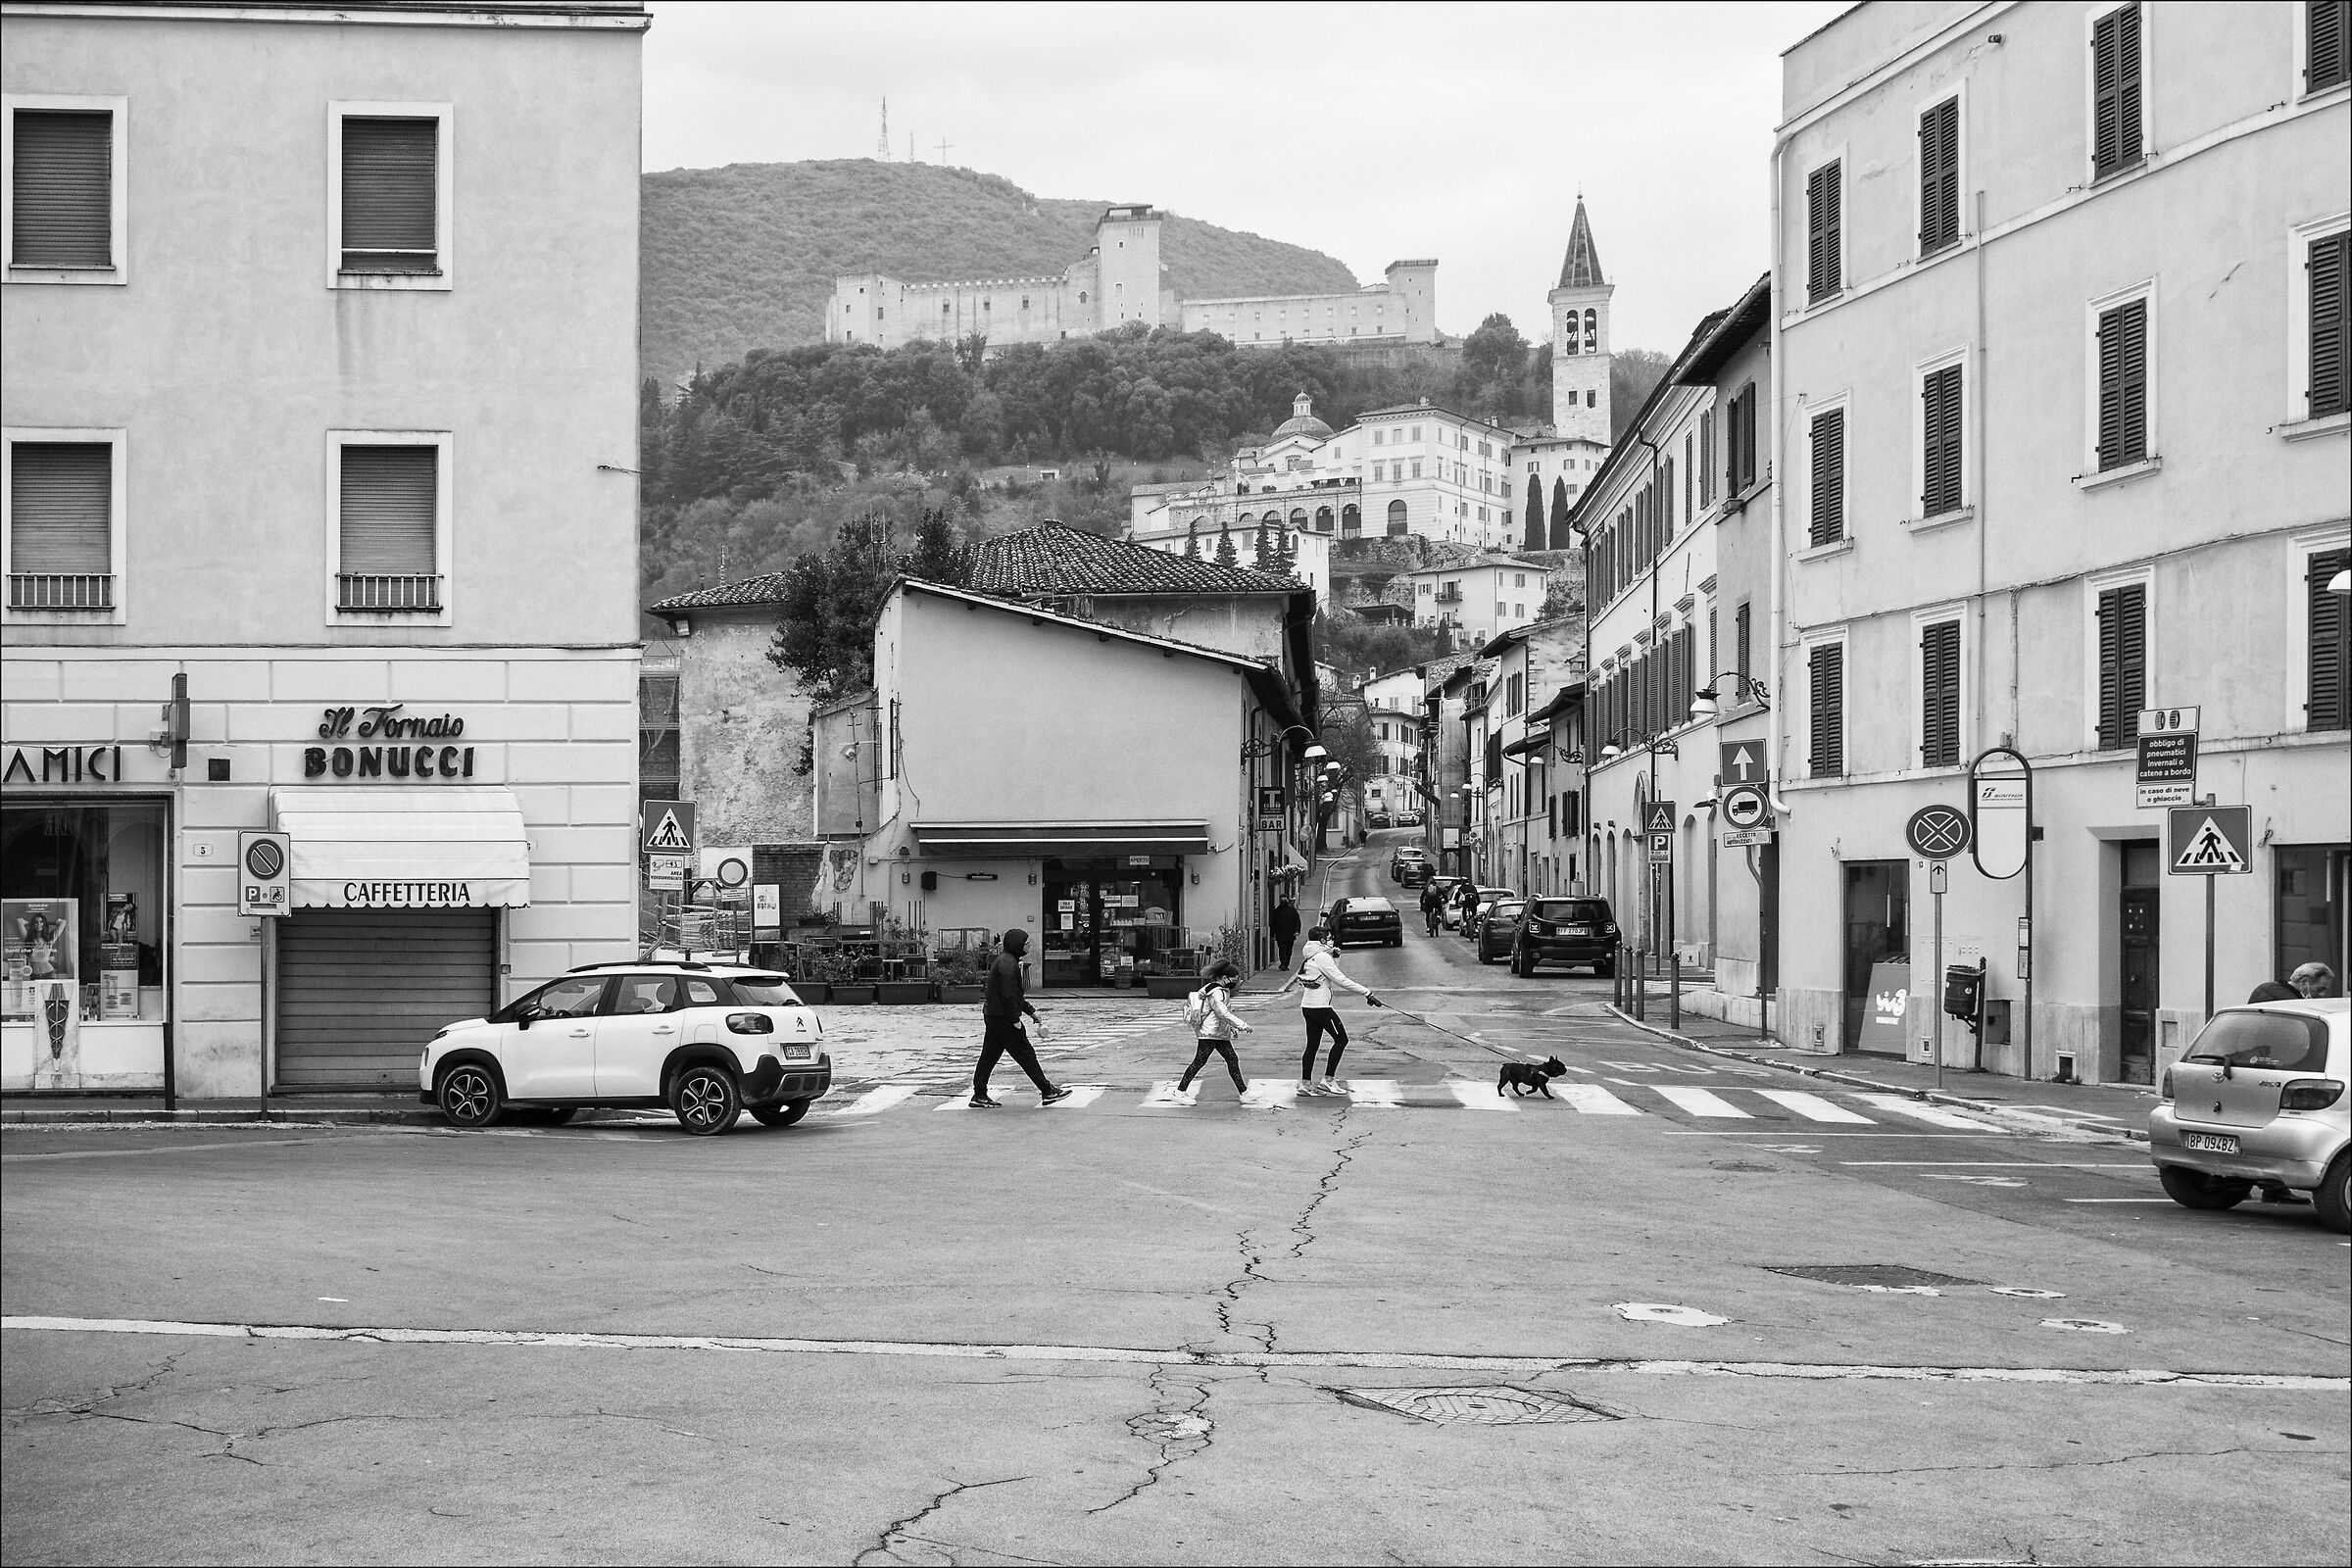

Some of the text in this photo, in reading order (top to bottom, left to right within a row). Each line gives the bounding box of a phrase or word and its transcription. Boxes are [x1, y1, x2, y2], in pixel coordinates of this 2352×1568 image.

[318, 703, 465, 738] Il Fornaio
[2149, 739, 2176, 748] obbligo
[2146, 749, 2186, 759] pneumatici
[3, 746, 121, 783] AMICI
[304, 745, 475, 777] BONUCCI
[2147, 759, 2178, 767] invernali
[2170, 767, 2192, 776] bordo
[2152, 795, 2182, 804] ghiaccio
[1261, 820, 1283, 829] BAR
[1654, 835, 1667, 850] P
[200, 846, 206, 856] 5
[248, 888, 258, 901] P
[343, 882, 470, 902] CAFFETTERIA
[2188, 1135, 2235, 1152] BP 094BZ
